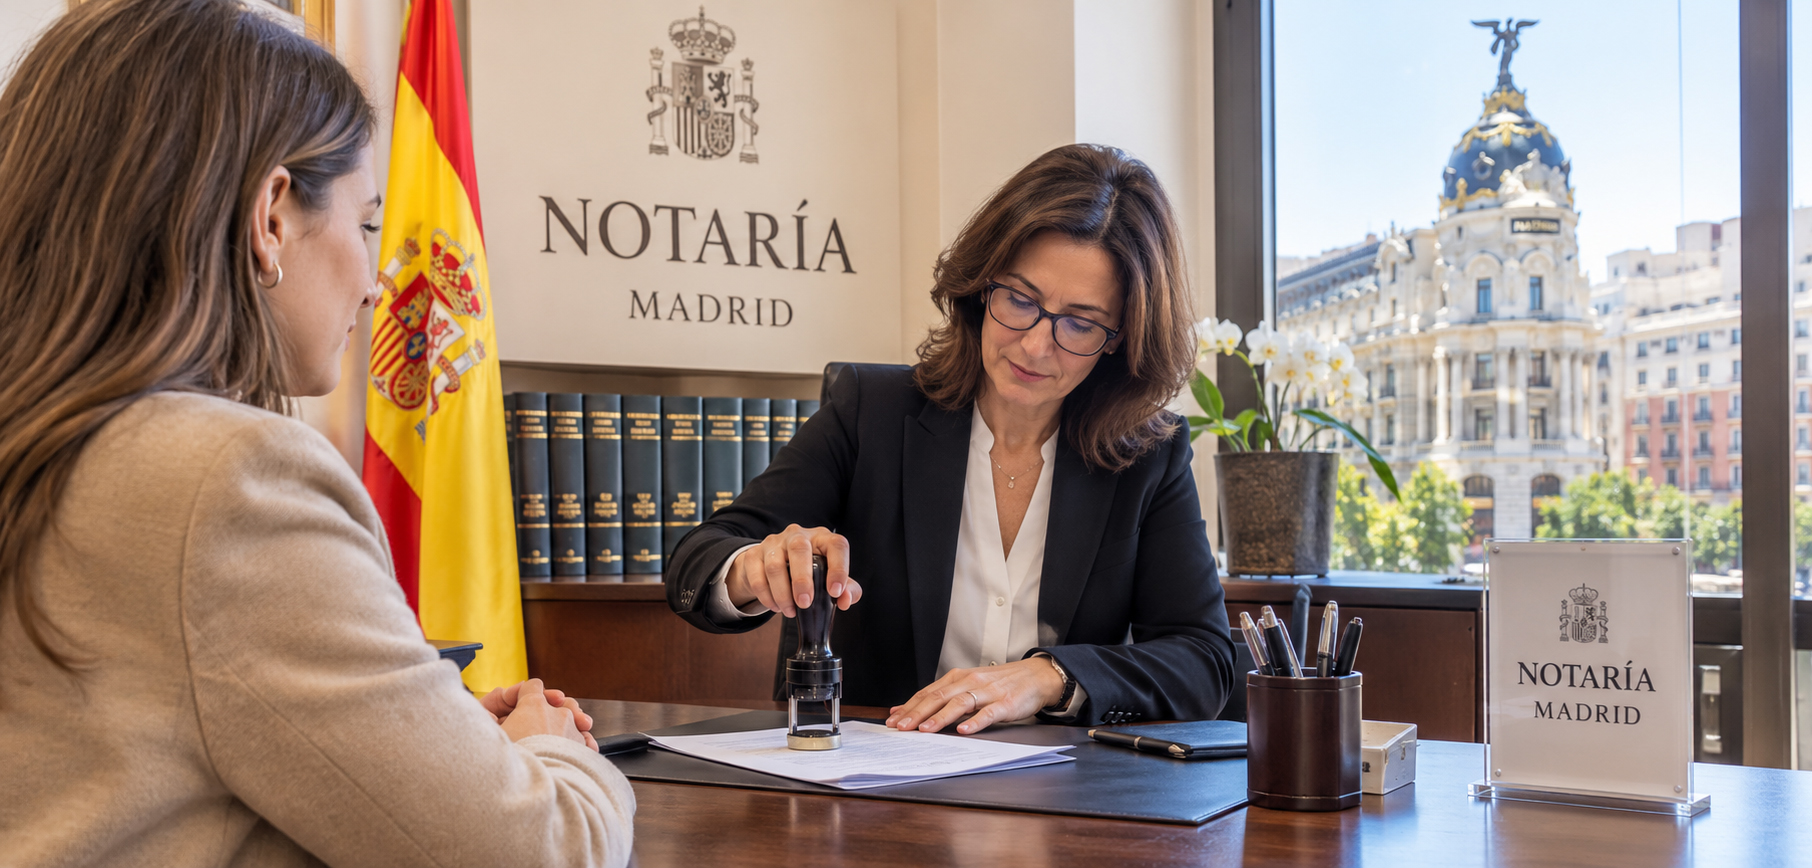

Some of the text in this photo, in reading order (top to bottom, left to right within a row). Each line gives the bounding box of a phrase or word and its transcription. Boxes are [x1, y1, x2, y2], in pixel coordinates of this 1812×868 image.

[539, 195, 857, 275] NOTARÍA
[629, 289, 793, 327] MADRID
[1517, 660, 1656, 692] NOTARÍA
[1534, 701, 1641, 725] MADRID
